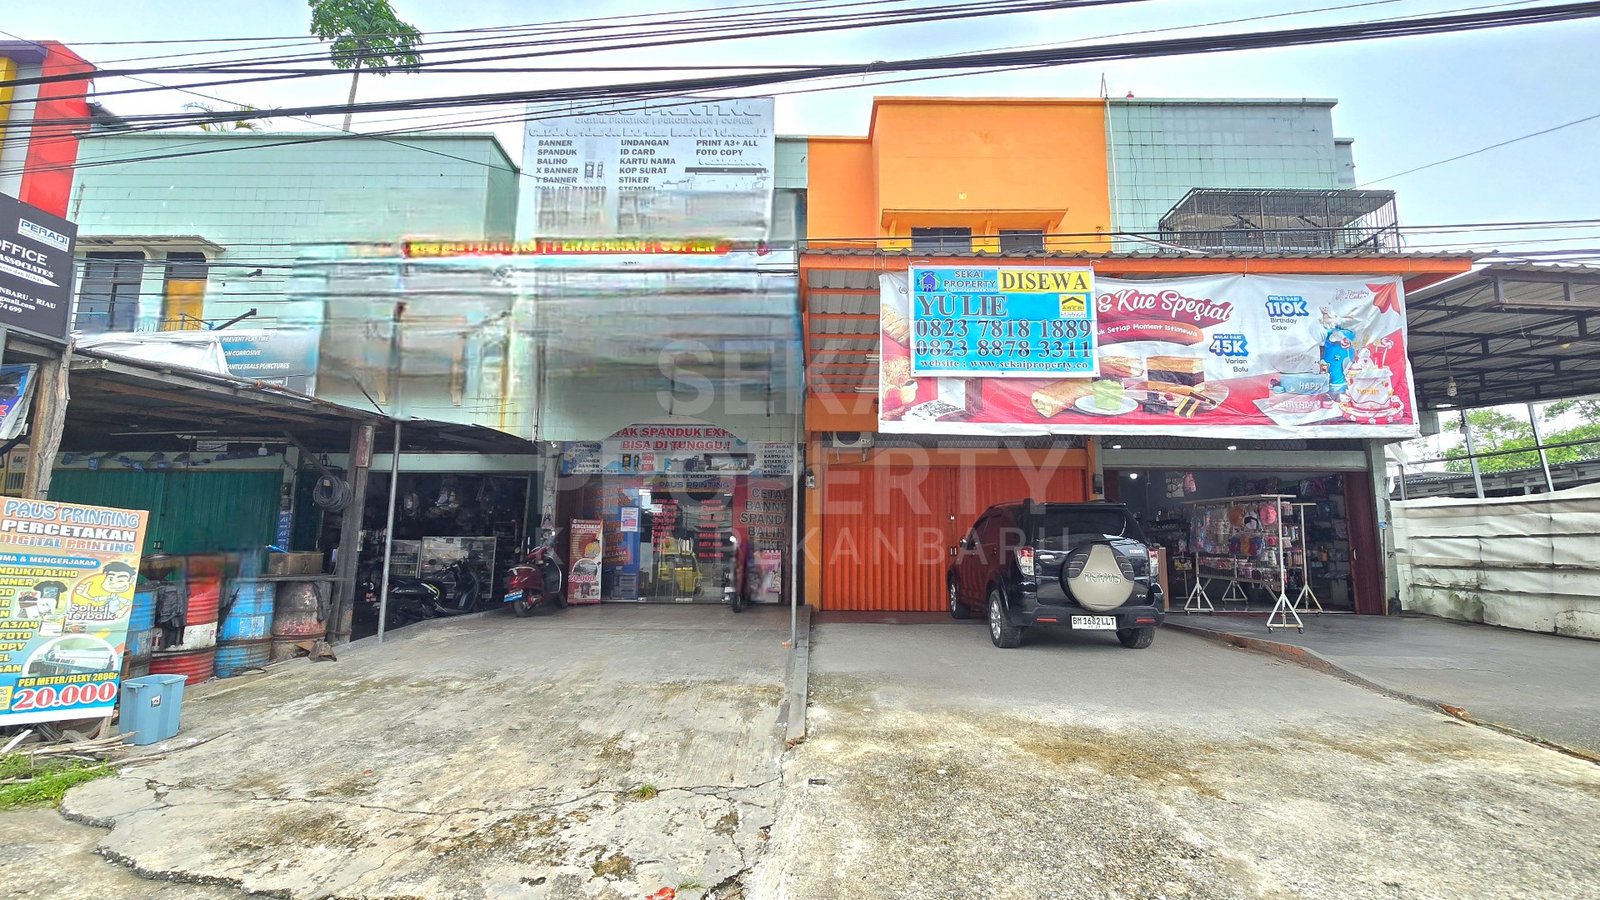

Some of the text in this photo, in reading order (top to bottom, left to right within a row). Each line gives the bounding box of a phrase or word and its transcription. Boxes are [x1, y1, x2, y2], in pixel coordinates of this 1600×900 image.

[538, 139, 573, 147] BANNER
[620, 139, 669, 147] UNDANGAN
[696, 139, 759, 147] PRINT A3+ ALL
[537, 148, 578, 156] SPANDUK
[618, 176, 650, 184] STIKER
[20, 219, 69, 246] PERADI
[0, 239, 48, 266] FFICE
[954, 270, 985, 279] SEKAI
[943, 279, 996, 288] PROPERTY
[1001, 272, 1089, 290] DISEWA
[36, 297, 57, 310] RIAU
[917, 295, 1008, 317] YU LIE
[1097, 294, 1113, 313] &
[1113, 289, 1157, 312] Kue
[8, 304, 23, 314] 699
[1266, 300, 1307, 316] 110K
[915, 318, 1092, 339] 0823 7818 1889
[1107, 325, 1131, 334] Setiap
[915, 340, 1091, 358] 0823 8878 3311
[1210, 339, 1246, 354] 45K
[260, 362, 291, 370] PUNCTURES
[920, 359, 960, 368] website
[970, 360, 1089, 370] www.sekaiproperty.co
[641, 426, 703, 438] SPANDUK
[621, 440, 651, 450] BISA
[653, 440, 668, 450] DI
[686, 481, 730, 489] PRINTING
[752, 488, 787, 499] CETA
[3, 500, 141, 529] PAUS PRINTING
[740, 512, 786, 525] SPAND
[2, 519, 136, 542] PERCETAKAN
[0, 534, 135, 553] DIGITAL PRINTING
[19, 555, 27, 563] &
[29, 556, 97, 567] MENGERJAKAN
[568, 574, 596, 583] 20.000
[70, 603, 110, 613] Solusi
[67, 611, 116, 621] Terbaik
[1073, 616, 1082, 625] BM
[1101, 617, 1115, 626] LLT
[0, 620, 39, 630] A3/A4
[18, 672, 119, 687] PER METER/FLEXY 280Gr
[11, 681, 118, 711] 20.000
